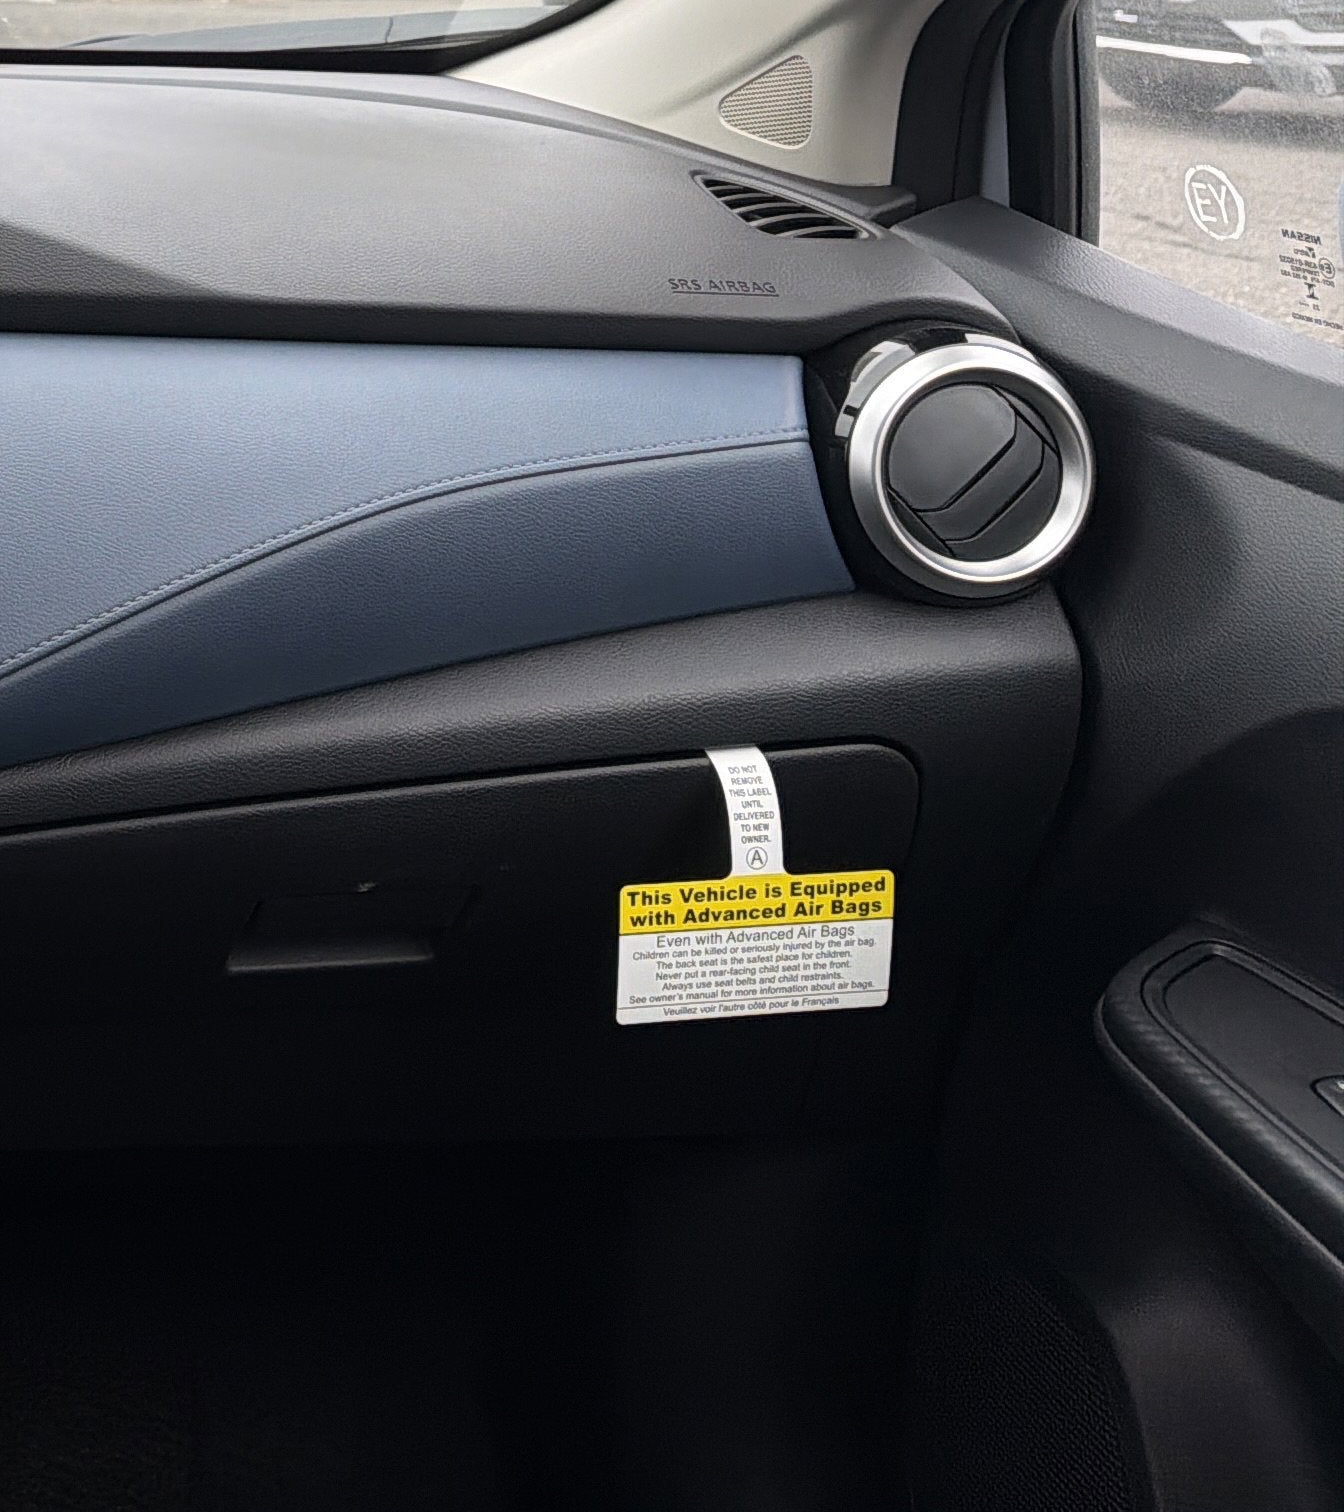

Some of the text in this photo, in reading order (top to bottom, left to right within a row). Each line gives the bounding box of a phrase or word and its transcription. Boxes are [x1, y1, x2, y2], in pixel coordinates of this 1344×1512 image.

[668, 278, 777, 294] SRS AIRBAG
[728, 765, 757, 775] DO NOT
[731, 776, 763, 785] REMOVE
[728, 787, 771, 797] THIS LABEL
[741, 800, 764, 809] UNTIL
[733, 811, 774, 821] DELIVERED
[741, 823, 769, 832] TO NEW
[750, 849, 764, 865] A
[627, 876, 886, 906] This Vehicle is Equipped
[629, 899, 882, 927] with Advanced Air Bags
[656, 925, 855, 948] Even with Advanced Air Bags
[632, 951, 669, 961] Children
[672, 950, 688, 958] can
[691, 948, 702, 957] be
[704, 946, 727, 956] killed
[741, 944, 780, 954] seriously
[783, 941, 813, 952] injured
[815, 939, 826, 949] by
[828, 938, 841, 947] the
[844, 937, 855, 946] air
[656, 961, 673, 970] The
[675, 958, 696, 968] back
[699, 957, 718, 966] seat
[721, 957, 728, 965] is
[730, 956, 744, 964] the
[746, 953, 773, 963] safest
[775, 952, 800, 963] place
[802, 951, 813, 960] for
[655, 972, 682, 981] Never
[684, 971, 698, 980] put
[709, 967, 756, 978] rear-facing
[759, 964, 779, 973] child
[782, 963, 800, 972] seat
[813, 961, 827, 970] the
[662, 982, 694, 992] Always
[714, 979, 734, 987] seat
[736, 977, 757, 986] belts
[759, 976, 775, 984] and
[778, 974, 799, 983] child
[629, 995, 646, 1004] See
[649, 992, 684, 1003] owner's
[686, 990, 718, 1000] manual
[721, 989, 732, 997] for
[735, 988, 758, 996] more
[760, 985, 808, 995] information
[811, 982, 836, 991] about
[838, 981, 849, 989] air
[663, 997, 839, 1016] Veuillez voir l'autre côté pour le Français
